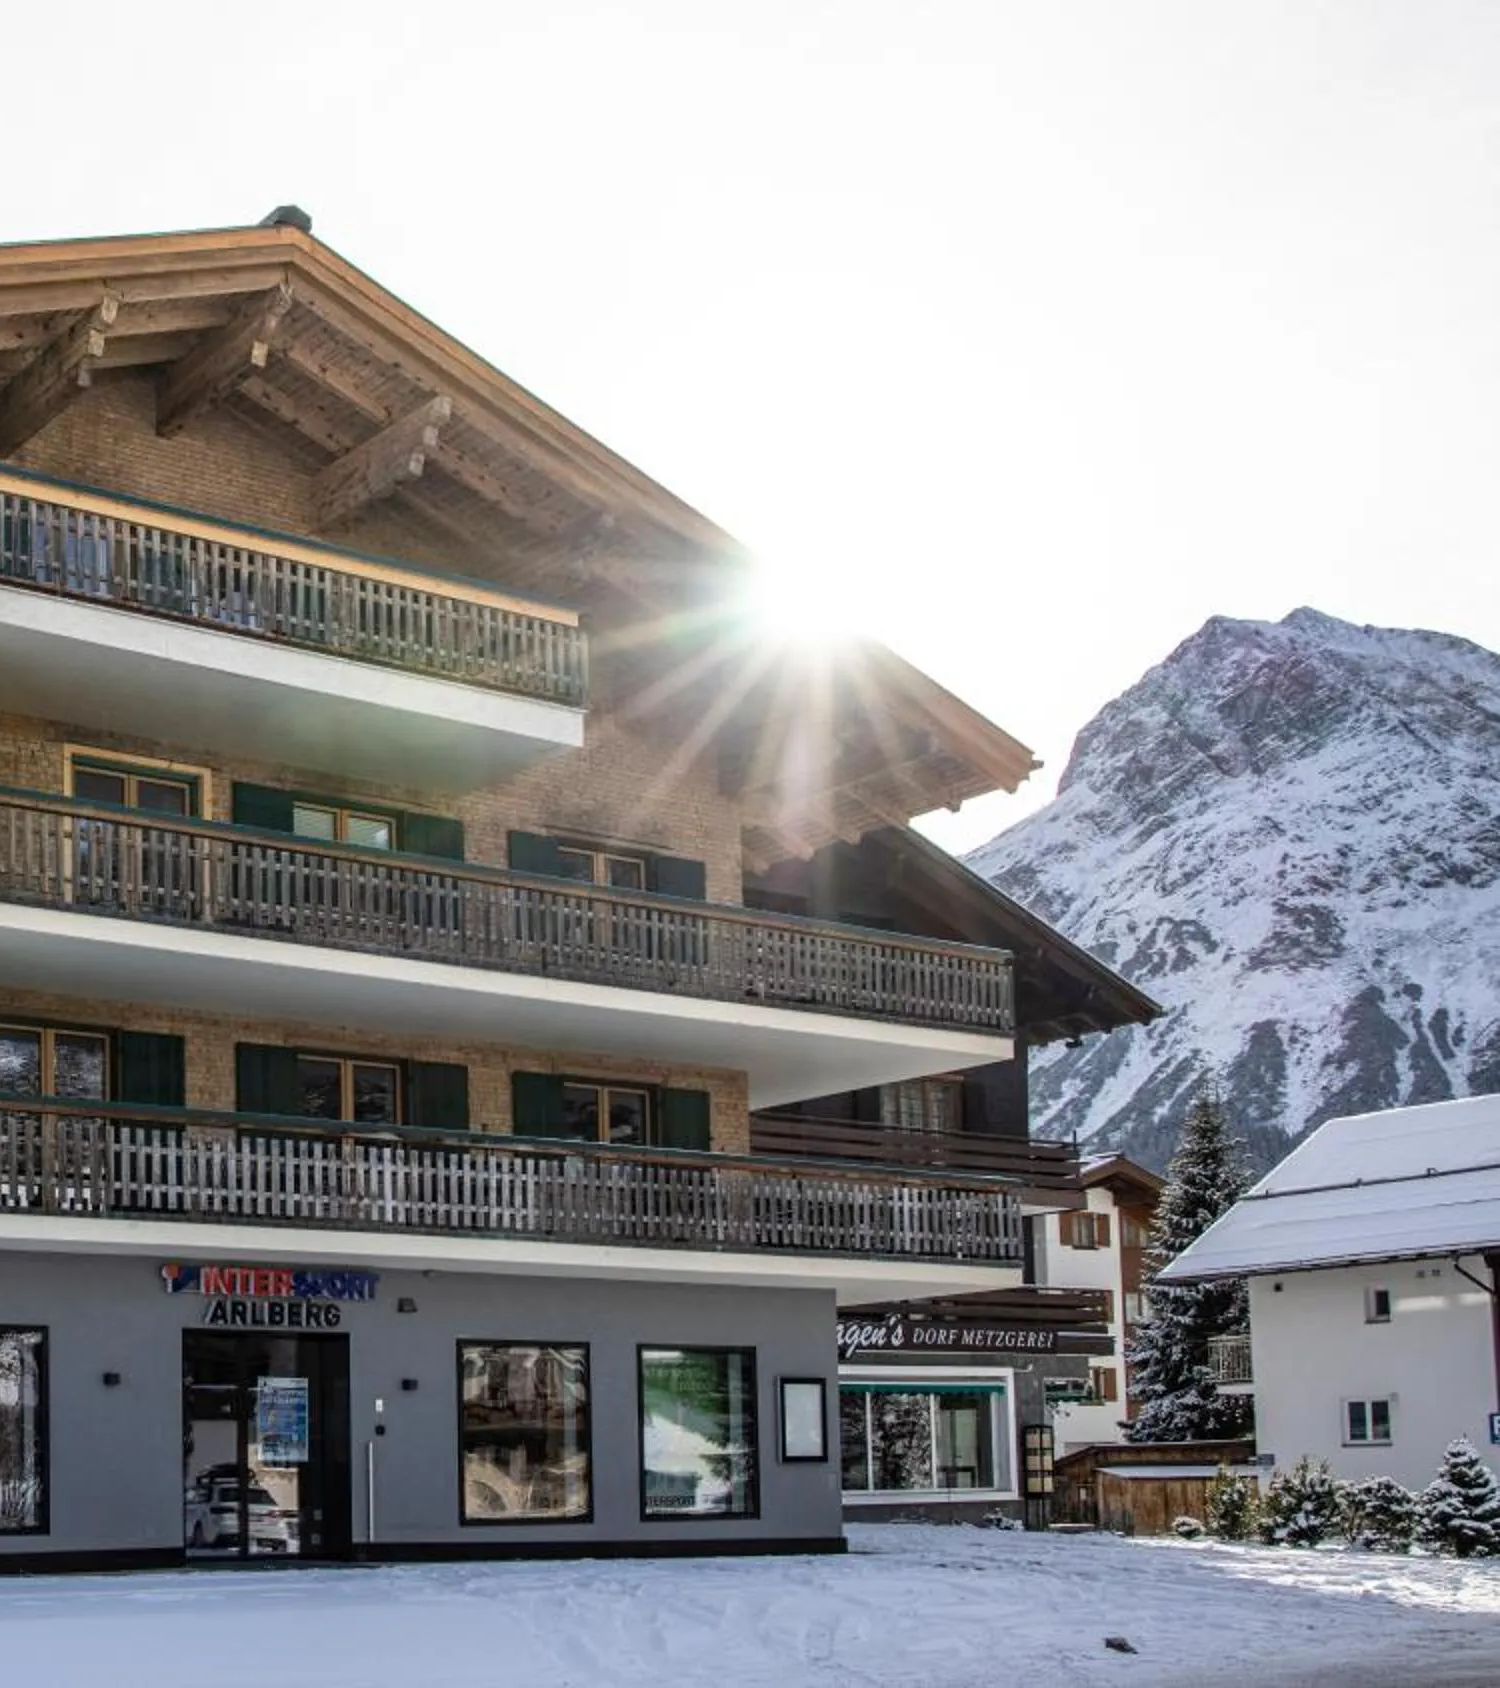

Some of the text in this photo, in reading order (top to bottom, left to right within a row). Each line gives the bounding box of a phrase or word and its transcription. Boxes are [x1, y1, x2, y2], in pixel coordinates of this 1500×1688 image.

[204, 1299, 341, 1328] ARLBERG
[912, 1327, 958, 1345] DORF
[961, 1329, 1054, 1348] METZGEREI
